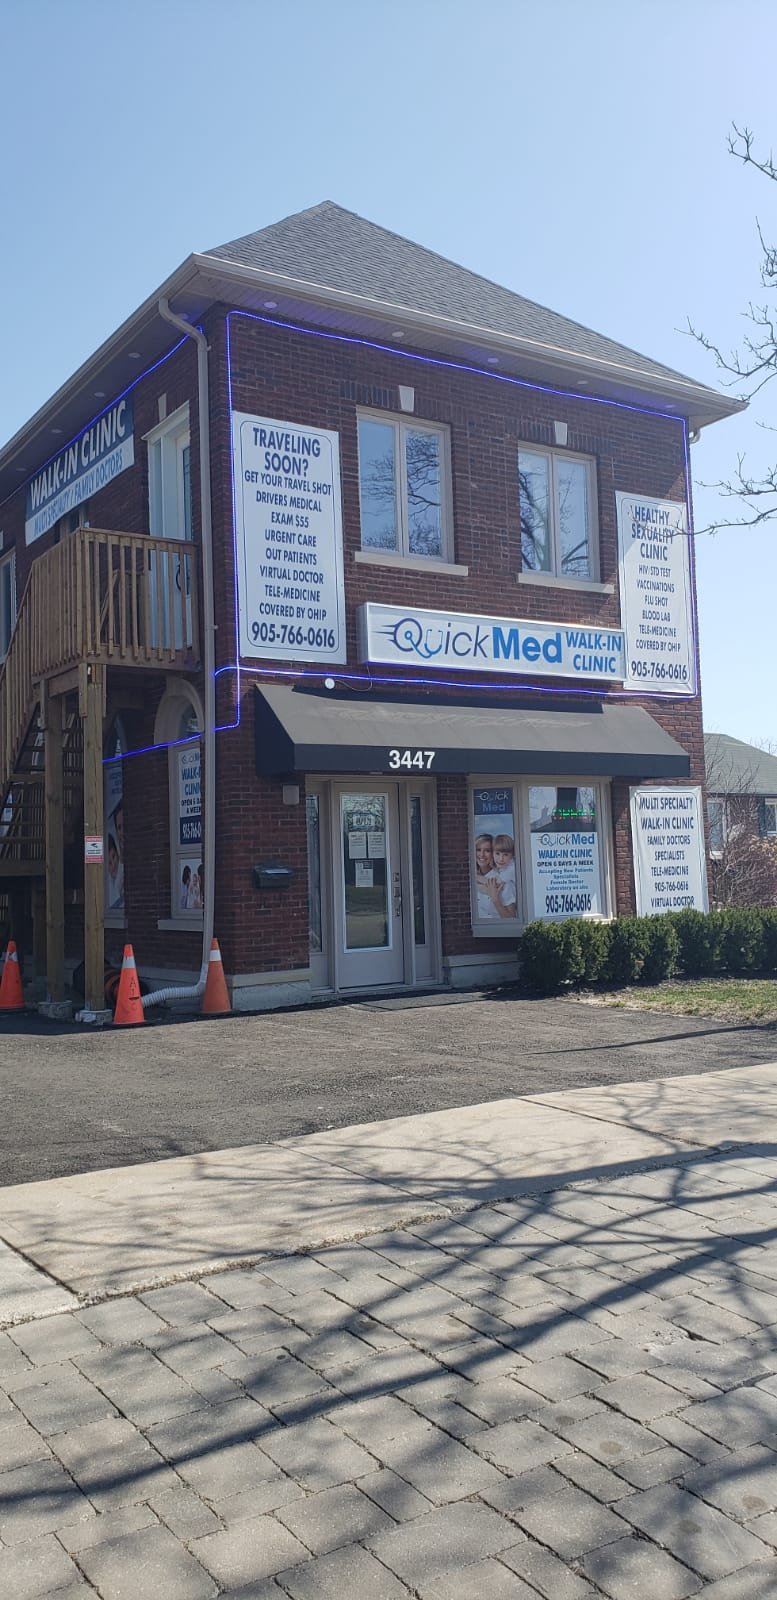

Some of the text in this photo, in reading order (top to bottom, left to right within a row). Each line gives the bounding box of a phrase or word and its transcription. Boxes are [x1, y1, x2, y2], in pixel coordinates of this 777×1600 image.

[253, 428, 320, 457] TRAVELING
[30, 400, 126, 510] WALK-IN CLINIC
[96, 450, 123, 489] DOCTORS
[265, 452, 309, 477] SOON?
[245, 470, 331, 496] GET YOUR TRAVEL SHOT
[256, 490, 322, 512] DRIVERS MEDICAL
[272, 512, 309, 528] EXAM $55
[635, 506, 670, 525] HEALTHY
[265, 529, 316, 547] URGENT CARE
[266, 548, 317, 566] OUT PATIENTS
[640, 543, 668, 561] CLINIC
[260, 565, 324, 584] VIRTUAL DOCTOR
[660, 568, 671, 578] TEST
[265, 585, 320, 602] TELE-MEDICINE
[637, 579, 674, 593] VACCINATIONS
[645, 595, 668, 606] FLU SHOT
[260, 603, 326, 621] COVERED BY OHIP
[642, 610, 670, 622] BLOOD LAB
[252, 622, 335, 648] 905-766-0616
[639, 625, 676, 637] TELE-MEDICINE
[566, 632, 622, 652] WALK-IN
[636, 640, 659, 650] COVERED
[660, 641, 667, 651] BY
[573, 654, 616, 673] CLINIC
[631, 660, 687, 680] 905-766-0616
[389, 749, 435, 769] 3447
[483, 802, 505, 811] Med
[640, 798, 693, 810] MULTI SPECIALTY
[641, 817, 694, 830] WALK-IN CLINIC
[648, 835, 690, 845] FAMILY DOCTORS
[538, 849, 592, 858] WALK-IN CLINIC
[655, 851, 685, 861] SPECIALISTS
[651, 866, 688, 876] TELE-MEDICINE
[655, 881, 688, 892] 905-766-0616
[546, 894, 591, 913] 905-766-0616
[651, 896, 694, 908] VIRTUAL DOCTOR
